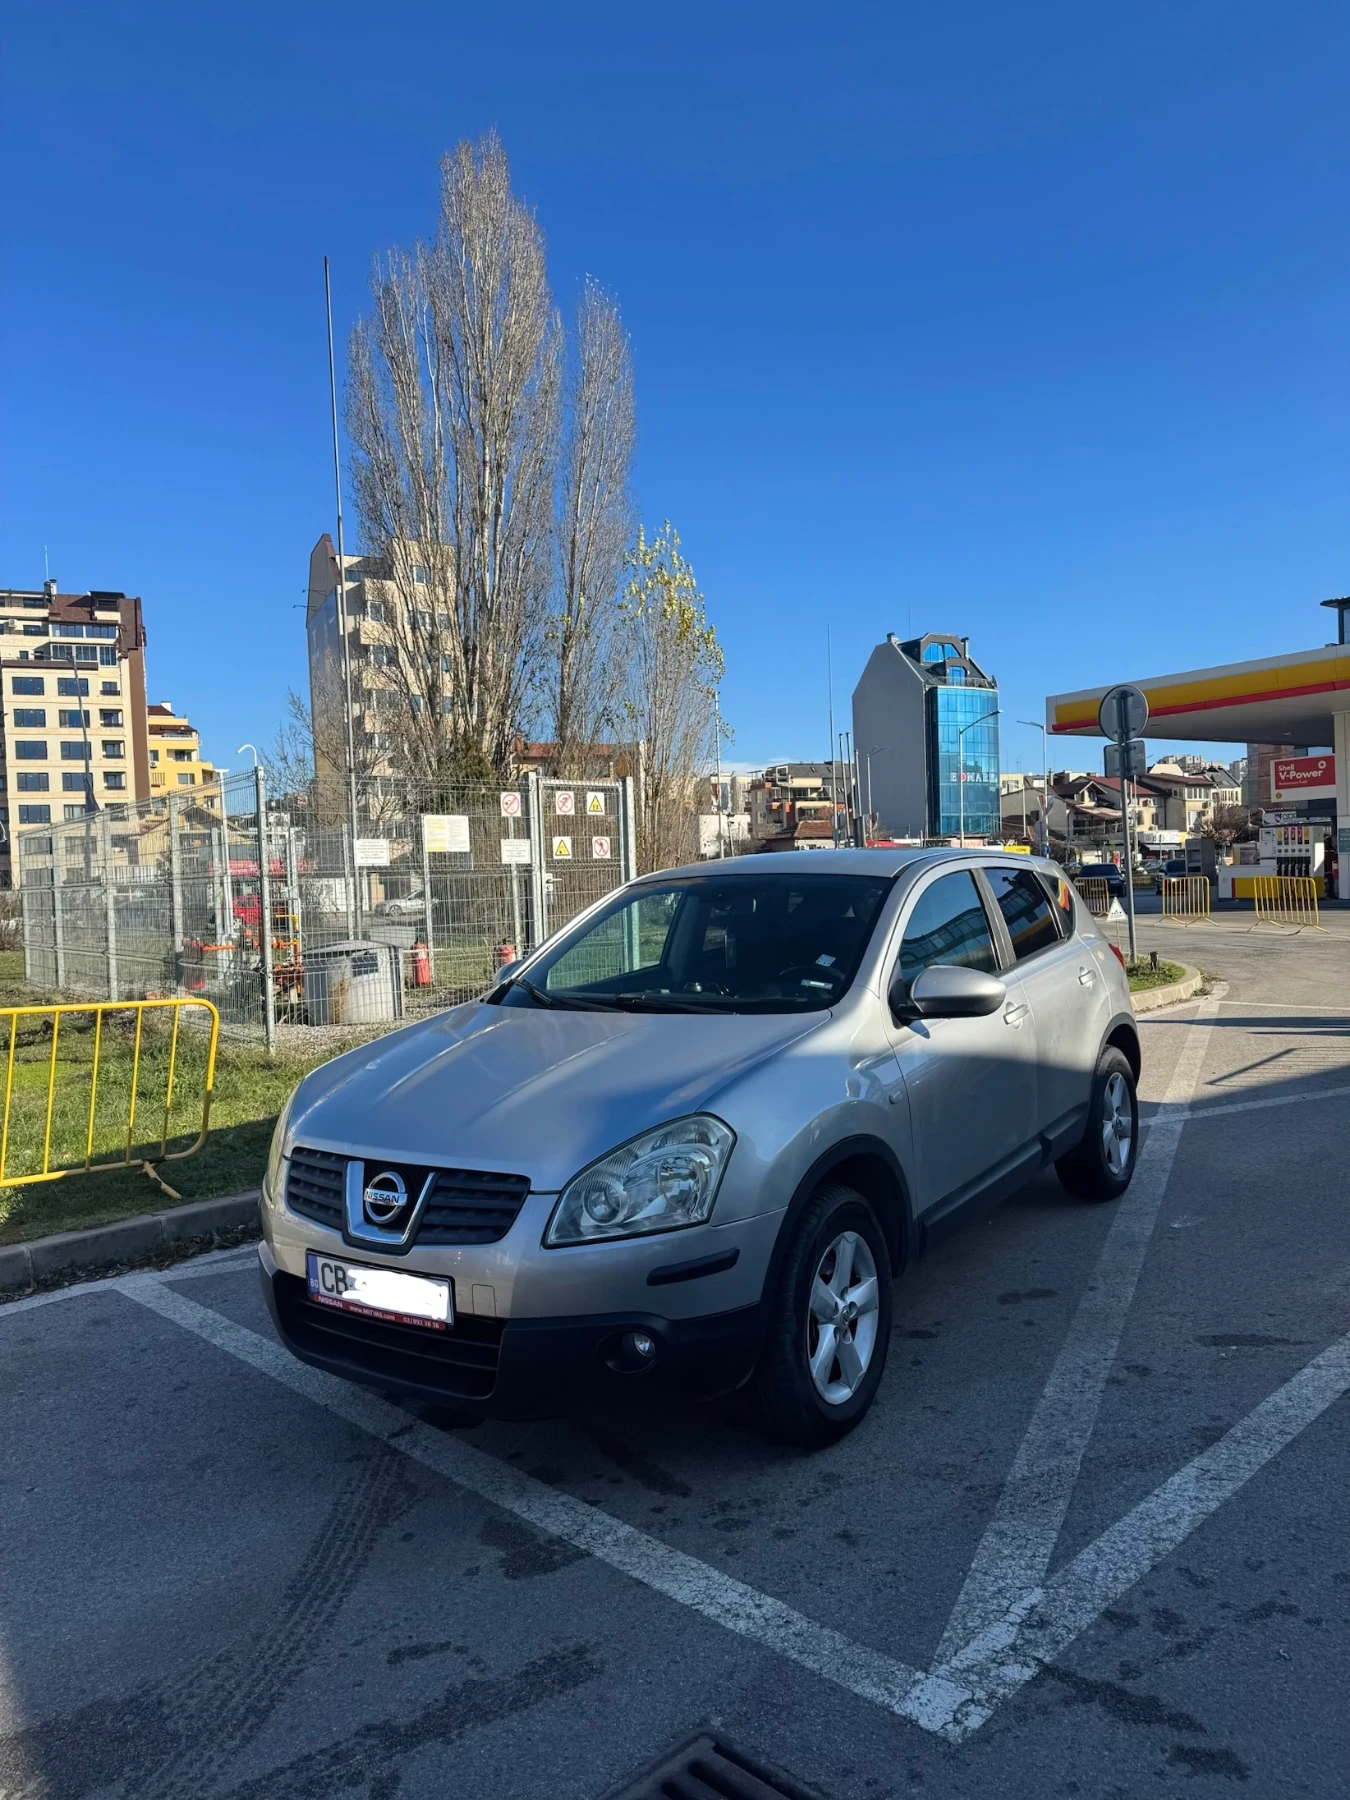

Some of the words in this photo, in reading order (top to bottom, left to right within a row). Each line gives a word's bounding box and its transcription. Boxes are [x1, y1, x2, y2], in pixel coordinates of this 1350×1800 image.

[1278, 764, 1295, 772] Shell
[1279, 770, 1323, 780] V-Power
[366, 1190, 400, 1204] NISSAN
[310, 1278, 319, 1288] BG
[320, 1262, 348, 1295] CB
[318, 1295, 343, 1308] NISSAN
[349, 1305, 396, 1321] www.MITVAS.com
